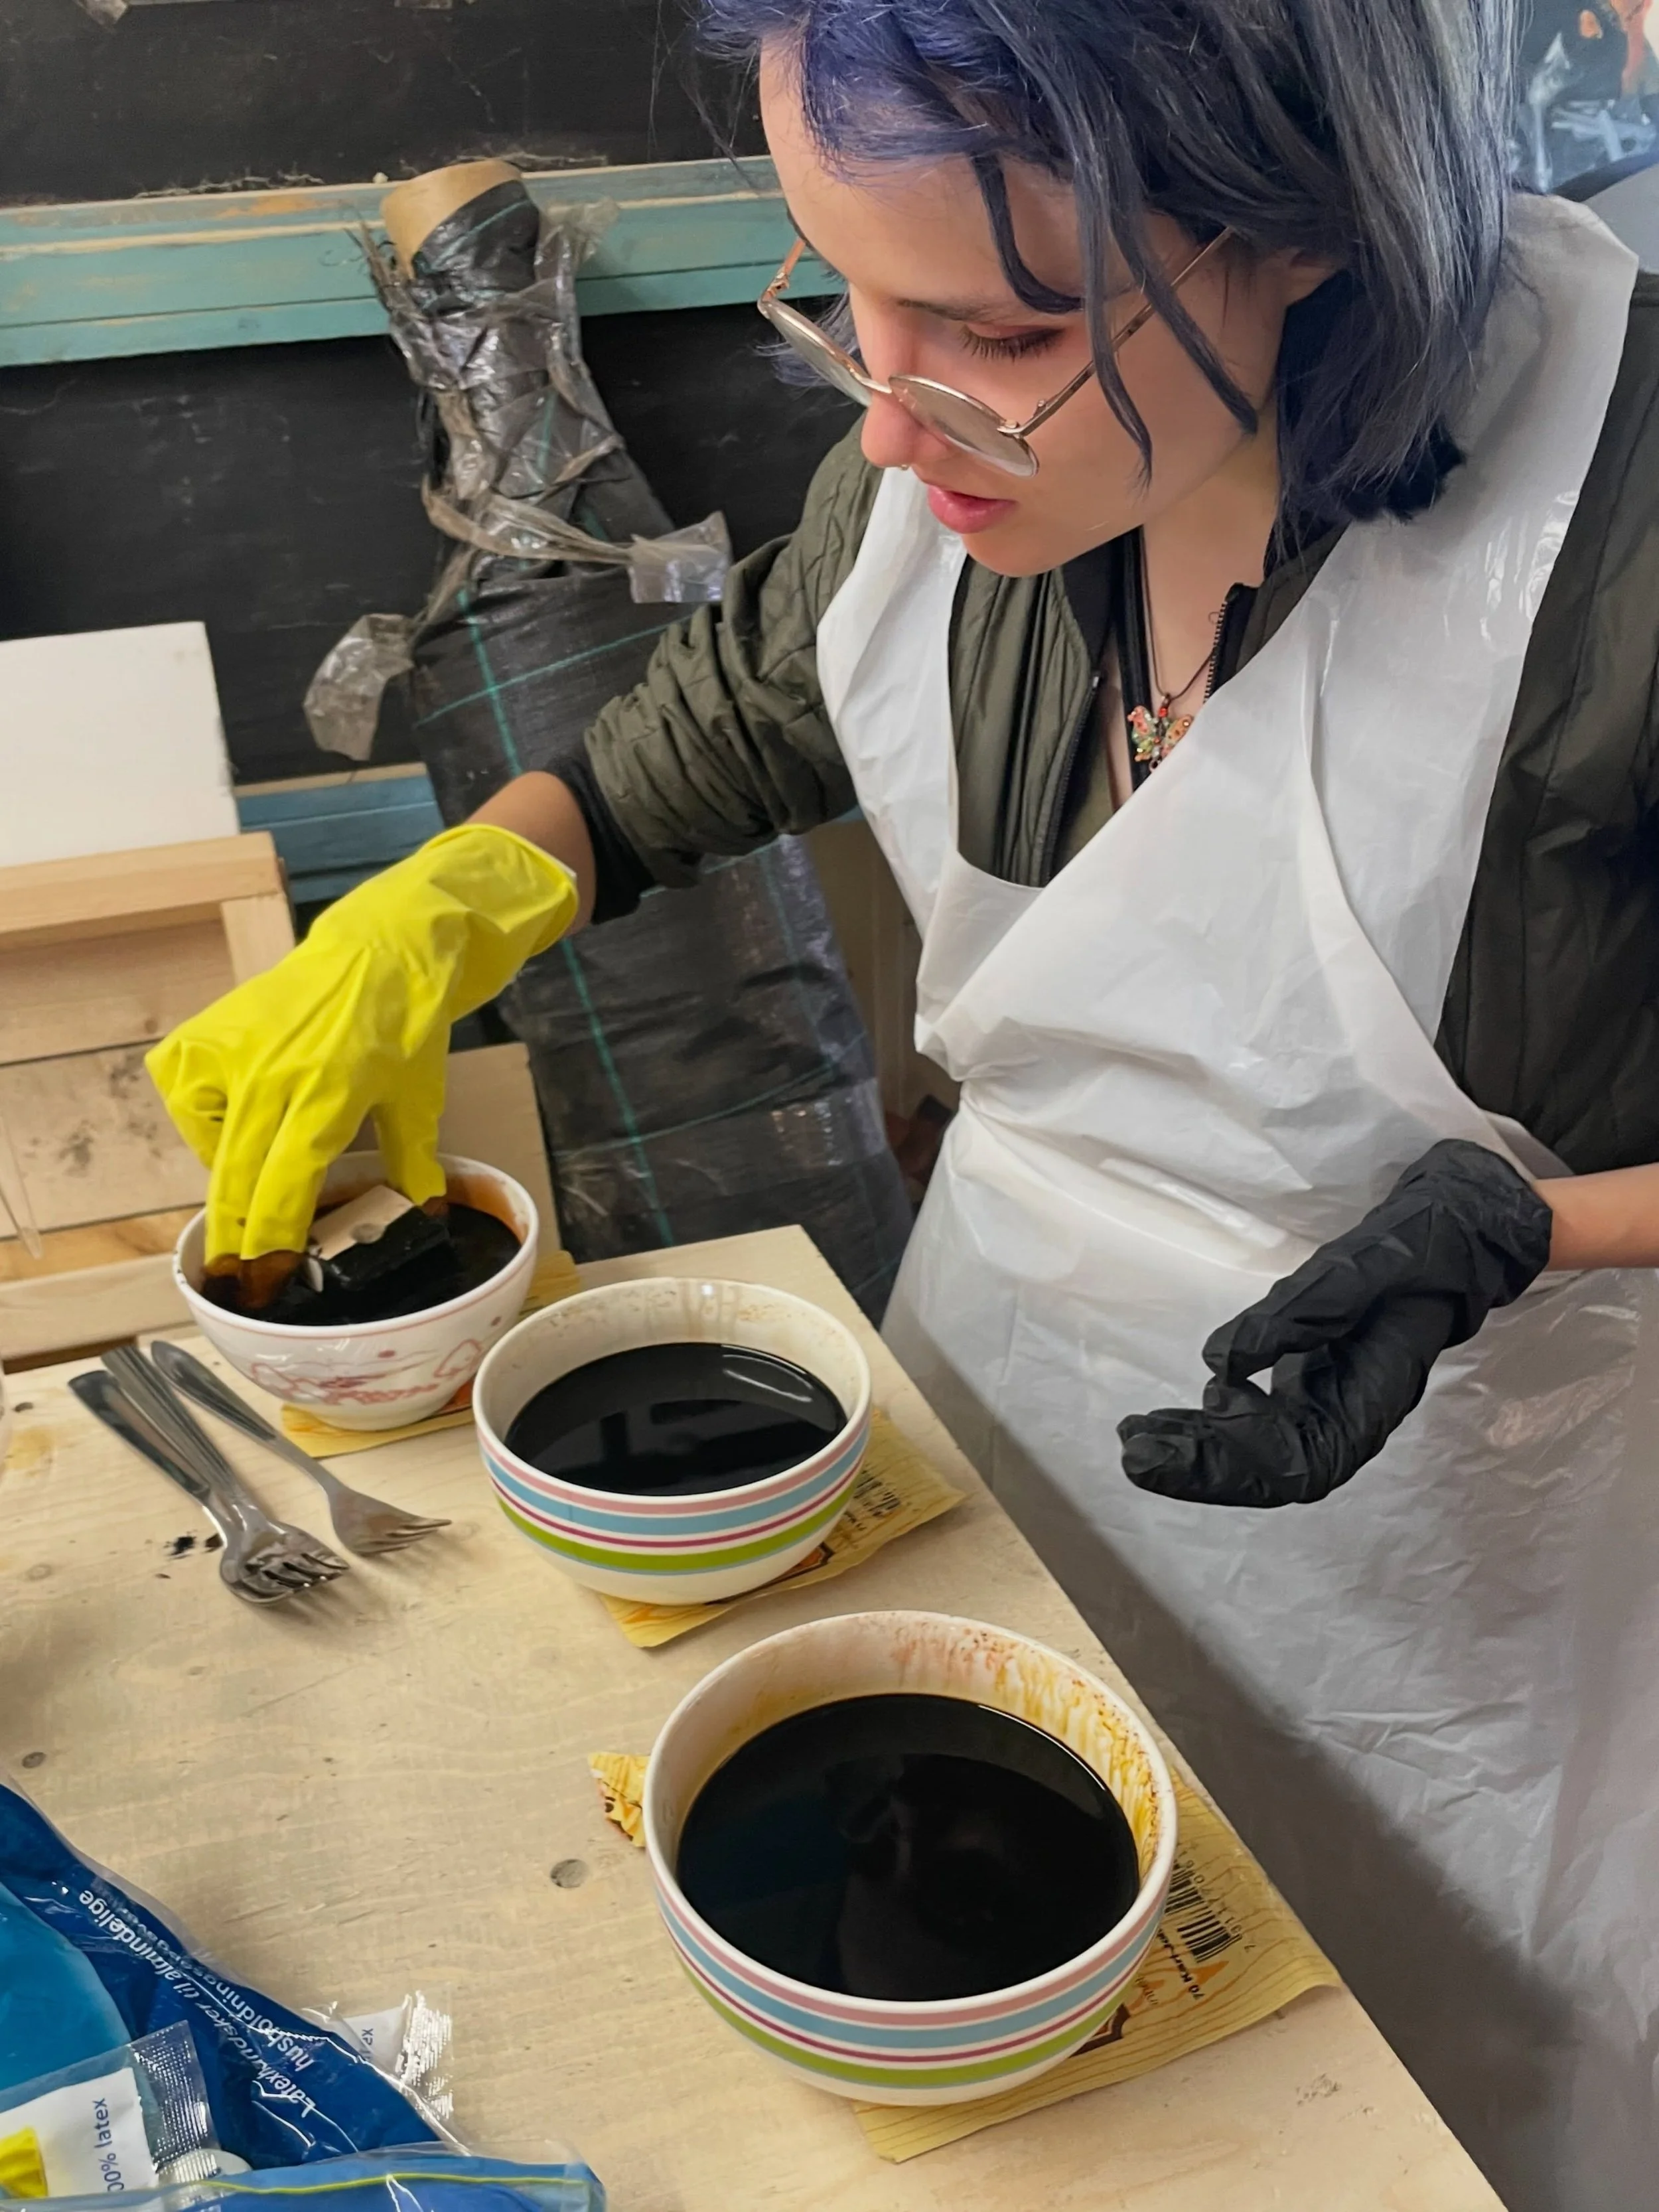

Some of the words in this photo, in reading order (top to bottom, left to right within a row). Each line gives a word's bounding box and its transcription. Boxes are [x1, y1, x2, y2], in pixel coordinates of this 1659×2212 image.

[79, 1889, 183, 1981] almindelige
[173, 1982, 200, 1999] til
[194, 2001, 317, 2118] Latexhandsker
[92, 2097, 113, 2149] latex
